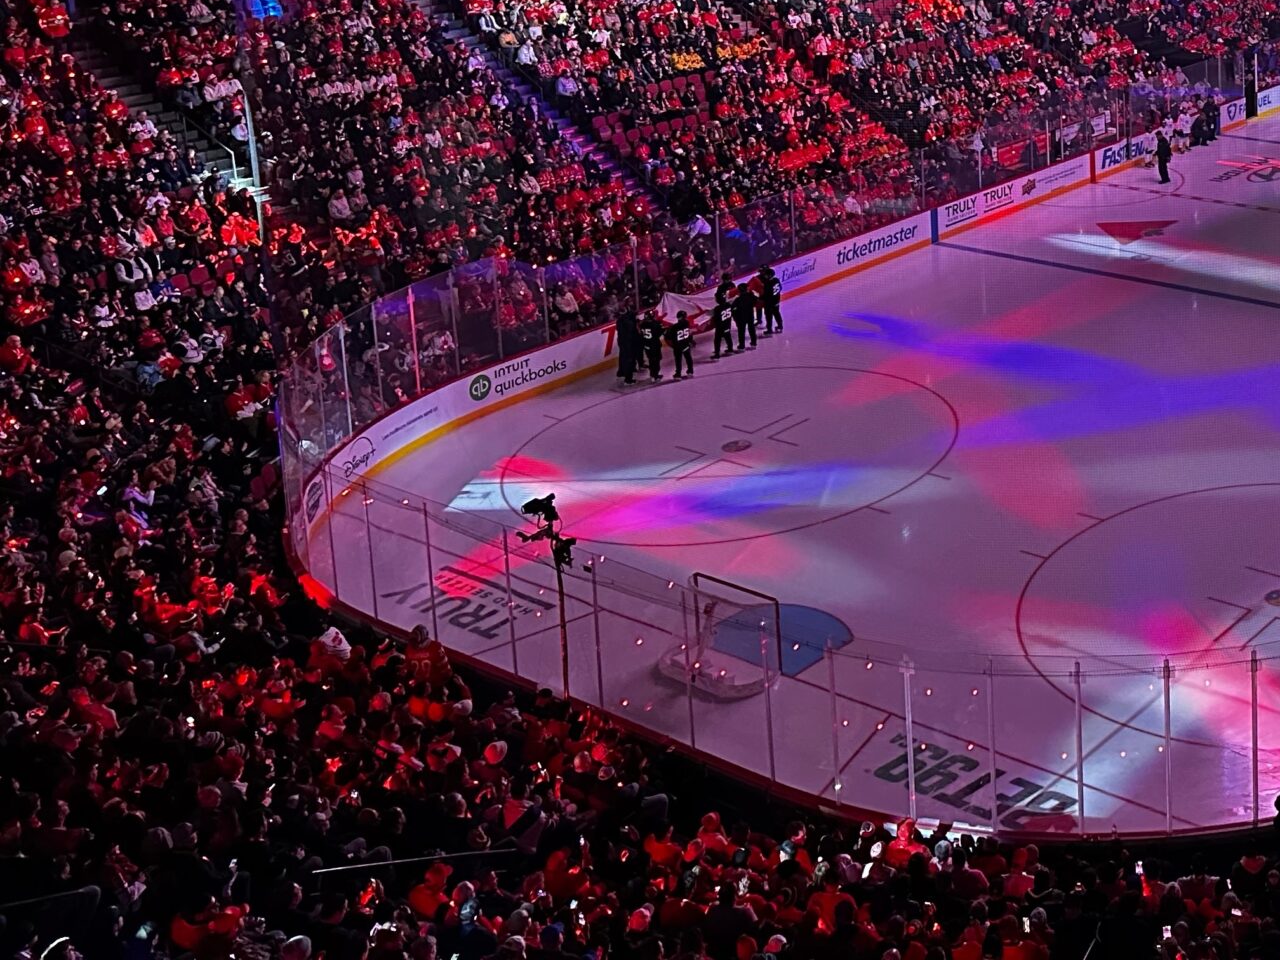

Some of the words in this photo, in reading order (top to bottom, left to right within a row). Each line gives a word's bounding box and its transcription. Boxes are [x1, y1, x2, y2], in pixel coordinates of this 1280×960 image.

[983, 183, 1014, 204] TRULY
[945, 196, 977, 218] TRULY
[836, 225, 918, 265] ticketmaster
[721, 308, 732, 321] 25
[677, 328, 690, 341] 25
[494, 358, 531, 379] INTUIT
[494, 360, 567, 396] quickbooks
[434, 574, 494, 600] SELTZER
[380, 583, 518, 640] TRULY
[873, 742, 1079, 831] BET99
